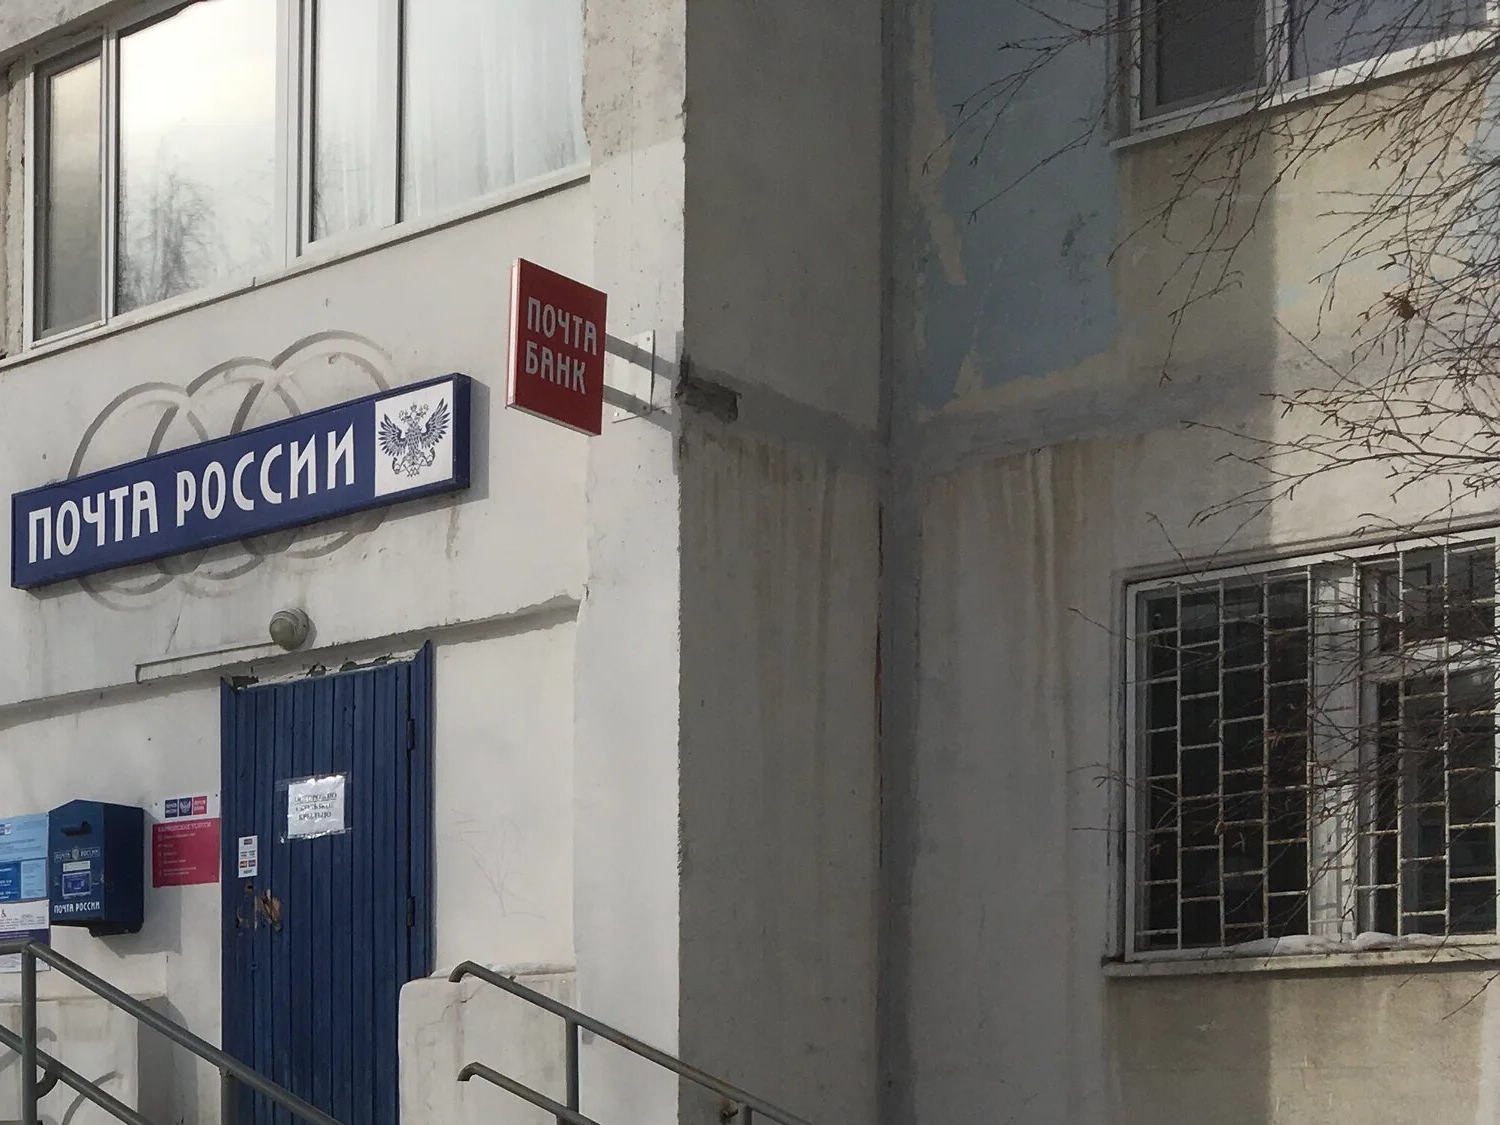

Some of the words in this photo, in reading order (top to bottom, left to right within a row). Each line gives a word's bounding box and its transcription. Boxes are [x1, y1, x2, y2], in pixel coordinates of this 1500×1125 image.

[526, 296, 598, 356] ПОЧТА
[525, 343, 588, 395] БАНК
[27, 480, 160, 564] ПОЧТА
[175, 422, 357, 528] РОССИИ
[53, 903, 74, 914] ПОЧТА
[75, 901, 101, 912] РОССИИ
